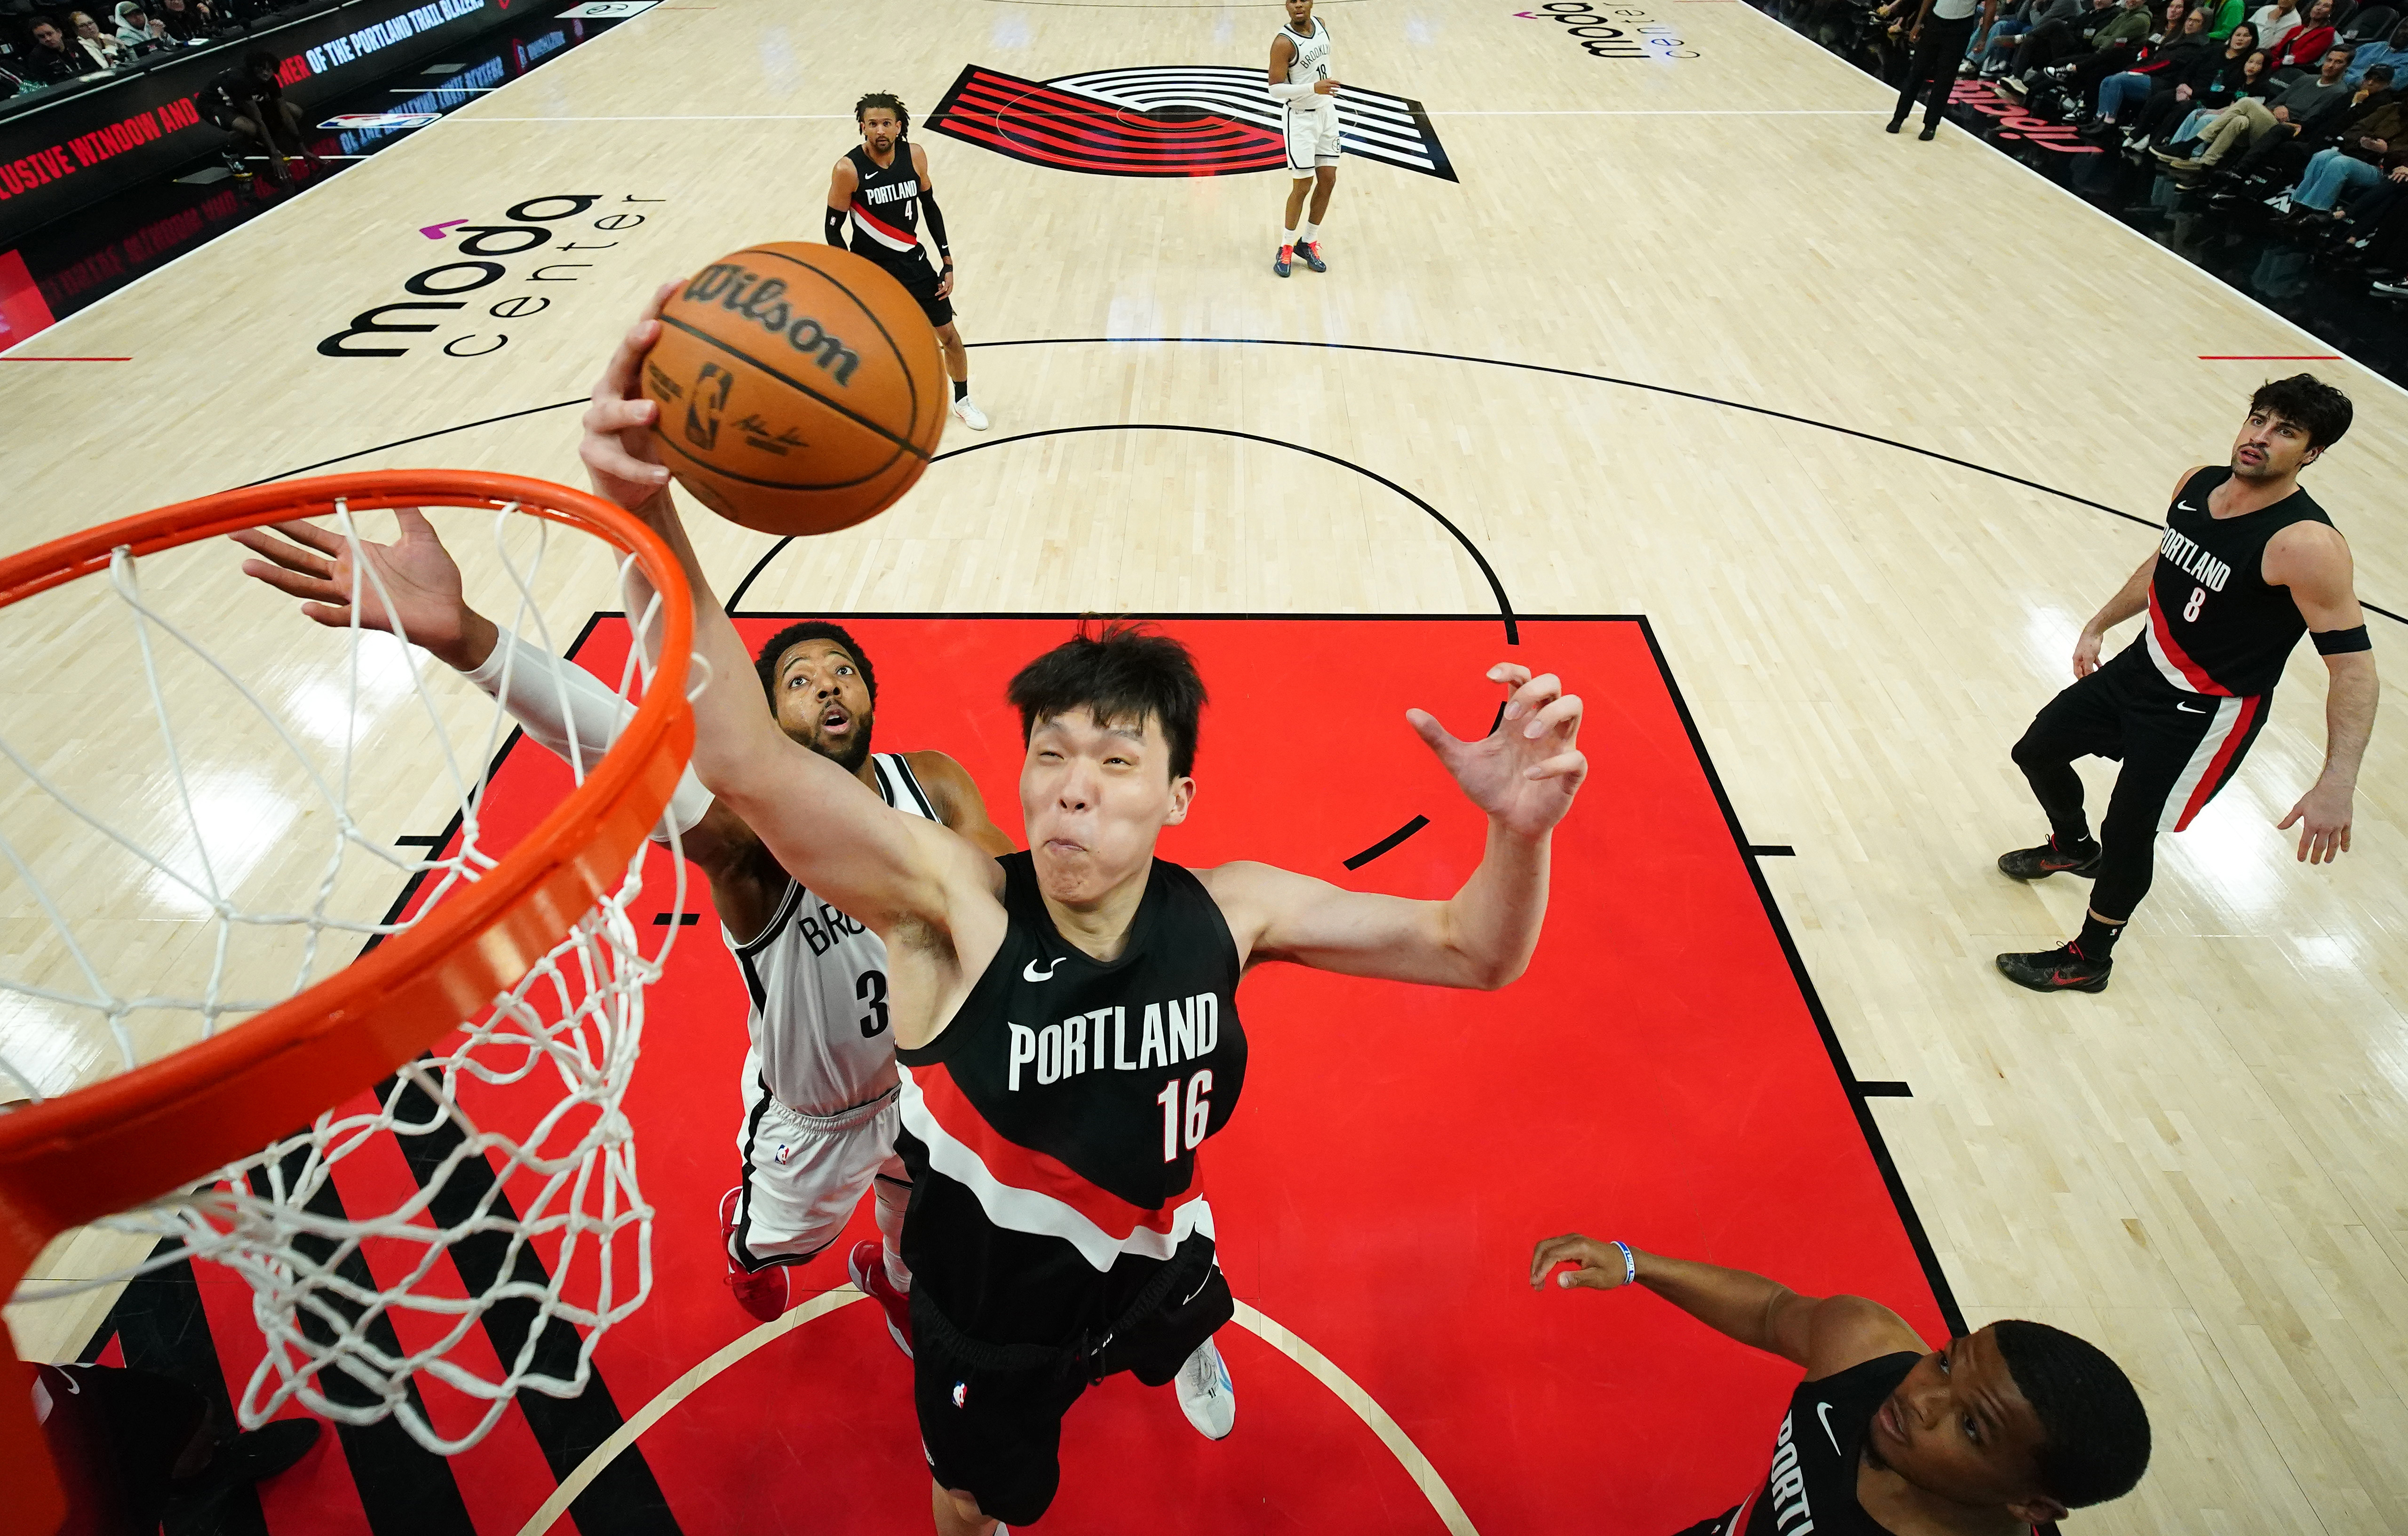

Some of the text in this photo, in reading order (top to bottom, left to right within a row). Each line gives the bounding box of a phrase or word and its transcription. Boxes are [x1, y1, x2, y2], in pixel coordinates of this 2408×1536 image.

[306, 47, 328, 74] OF
[323, 37, 355, 66] THE
[349, 16, 413, 57] PORTLAND
[407, 3, 445, 33] TRAIL
[1535, 2, 1651, 58] moda
[1603, 2, 1700, 58] center
[1316, 64, 1327, 80] 18
[67, 111, 161, 167] WINDOW
[157, 97, 199, 133] AND
[865, 180, 917, 205] PORTLAND
[905, 200, 913, 220] 4
[317, 194, 604, 357] moda
[443, 194, 666, 357] center
[682, 263, 860, 387] Wilson
[2183, 587, 2206, 622] 8
[856, 970, 889, 1038] 3
[1008, 992, 1218, 1091] PORTLAND
[1157, 1068, 1213, 1163] 16
